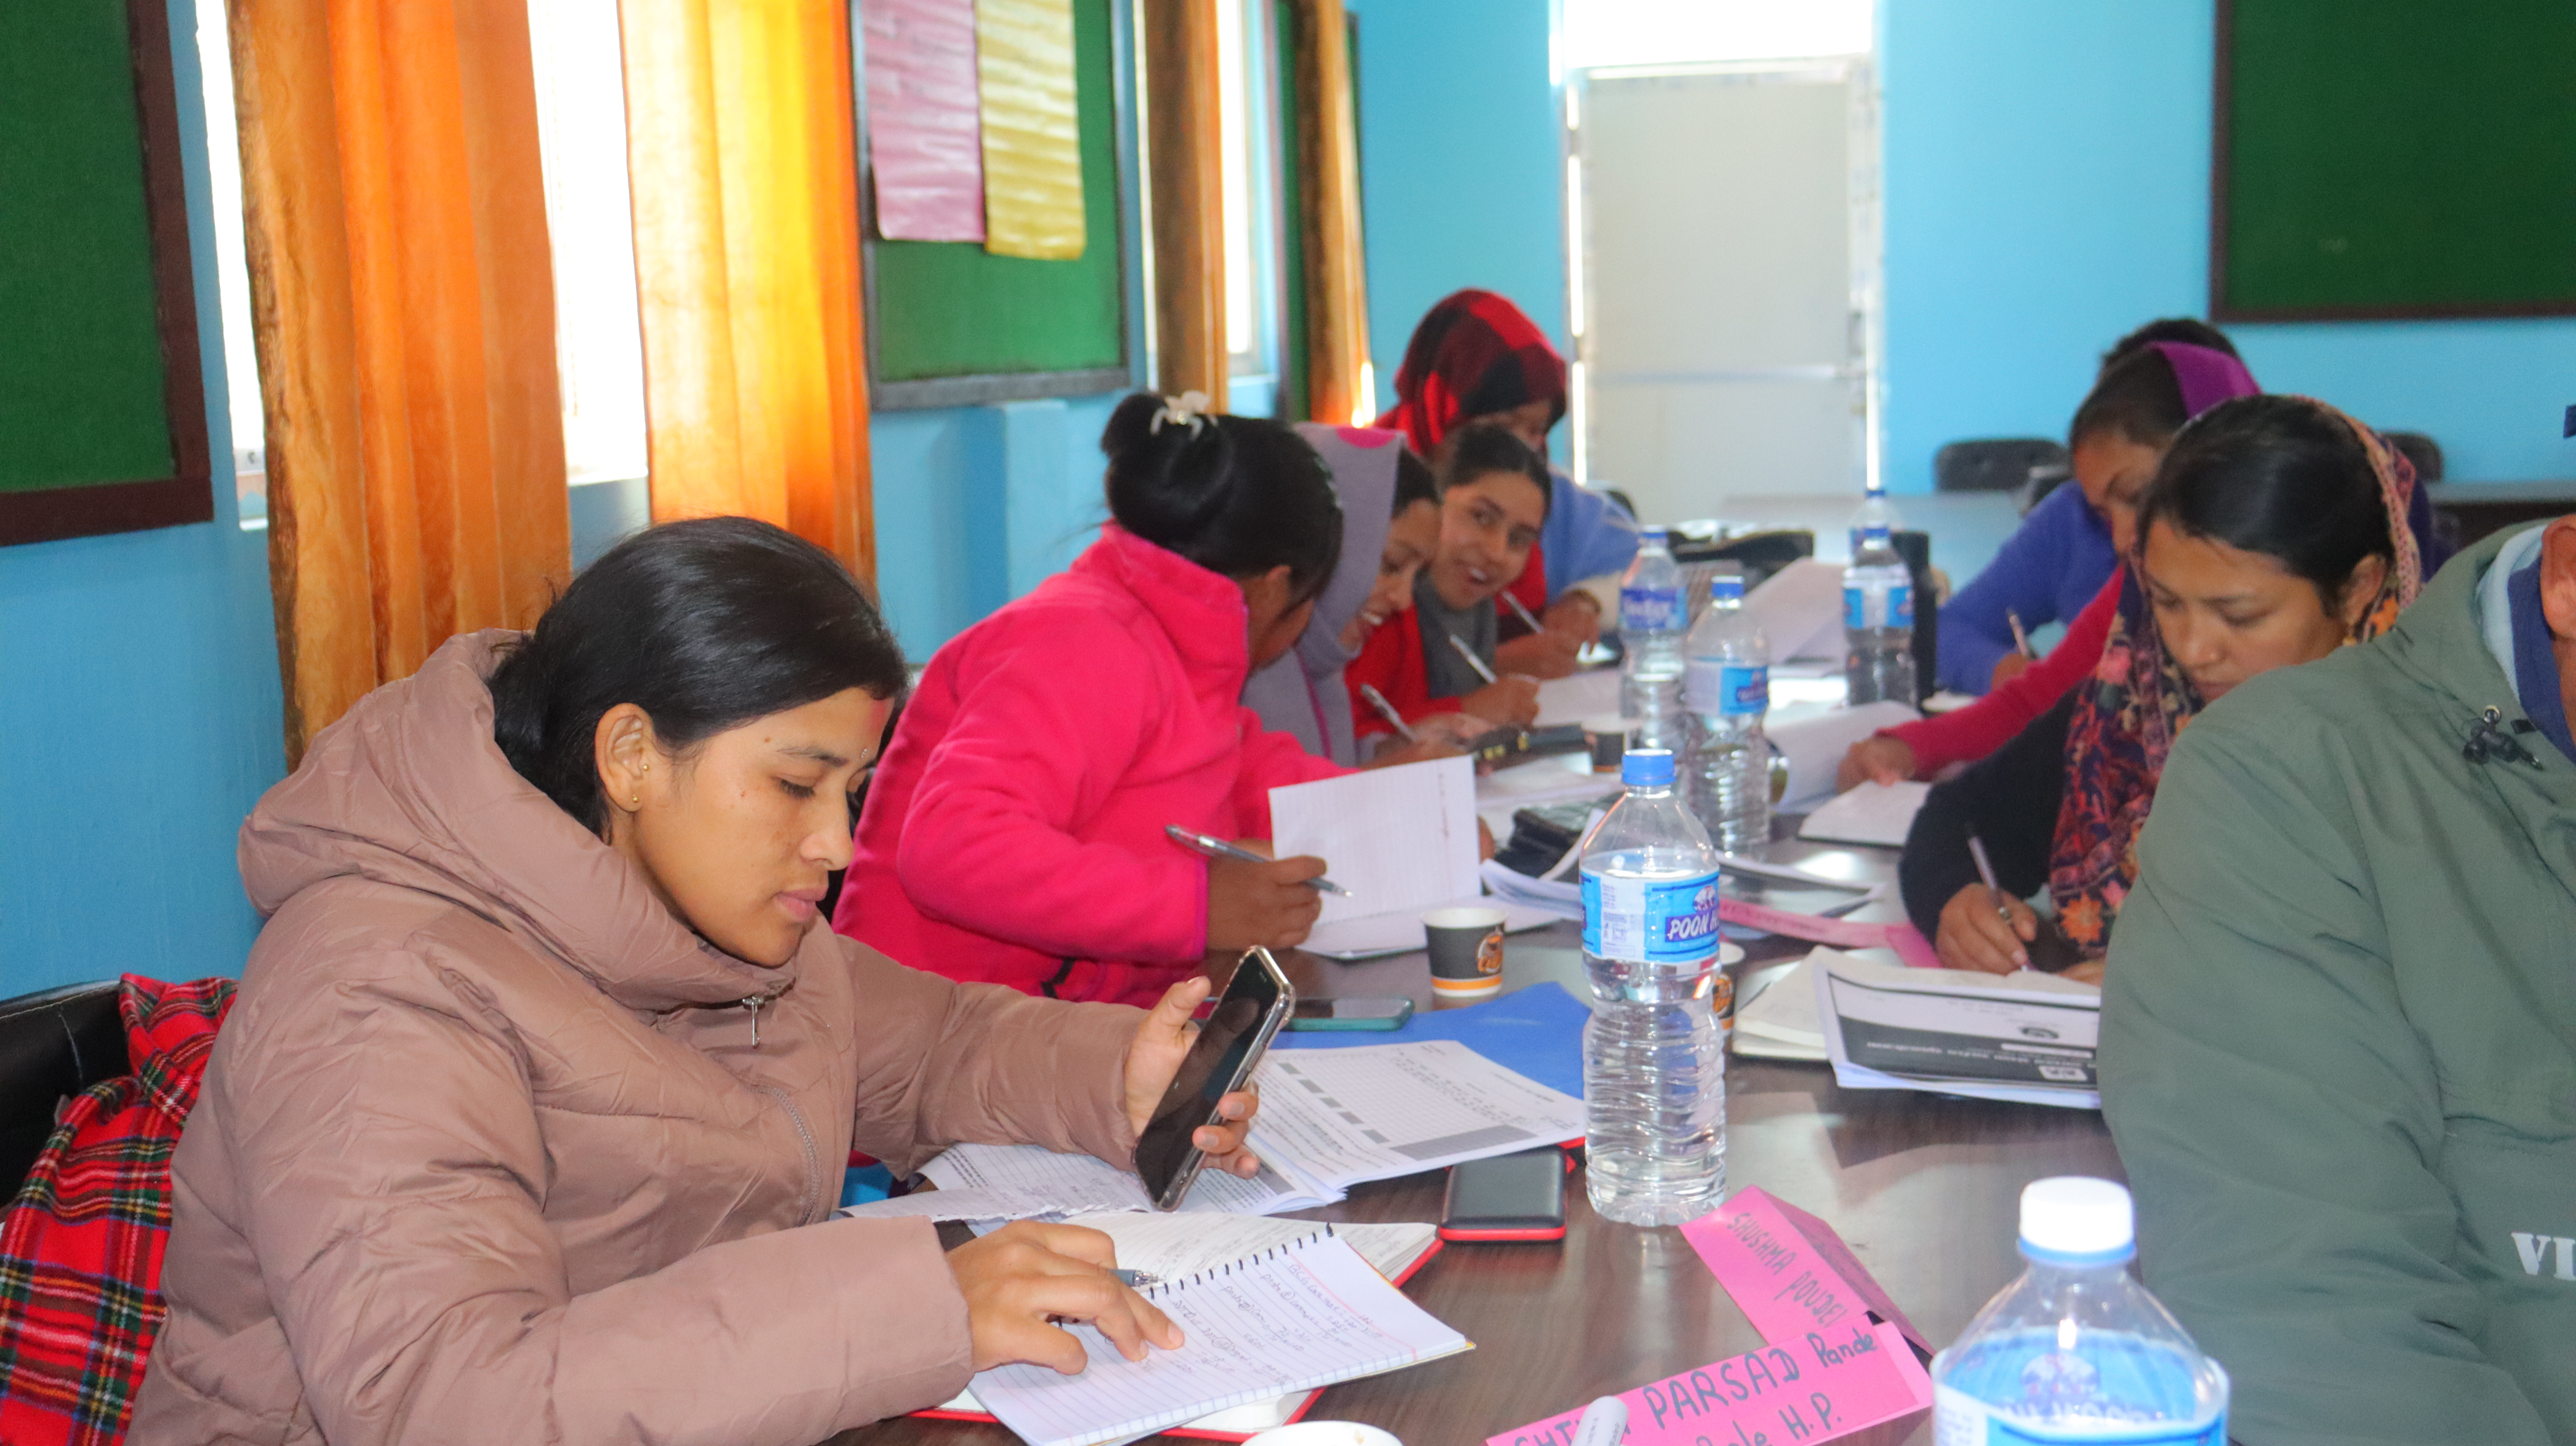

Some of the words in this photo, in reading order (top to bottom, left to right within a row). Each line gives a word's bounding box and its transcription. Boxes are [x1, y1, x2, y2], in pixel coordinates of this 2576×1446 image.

[1668, 913, 1709, 940] POON
[1726, 1212, 1797, 1275] SHUSHMA
[1643, 1348, 1800, 1430] PARSAD
